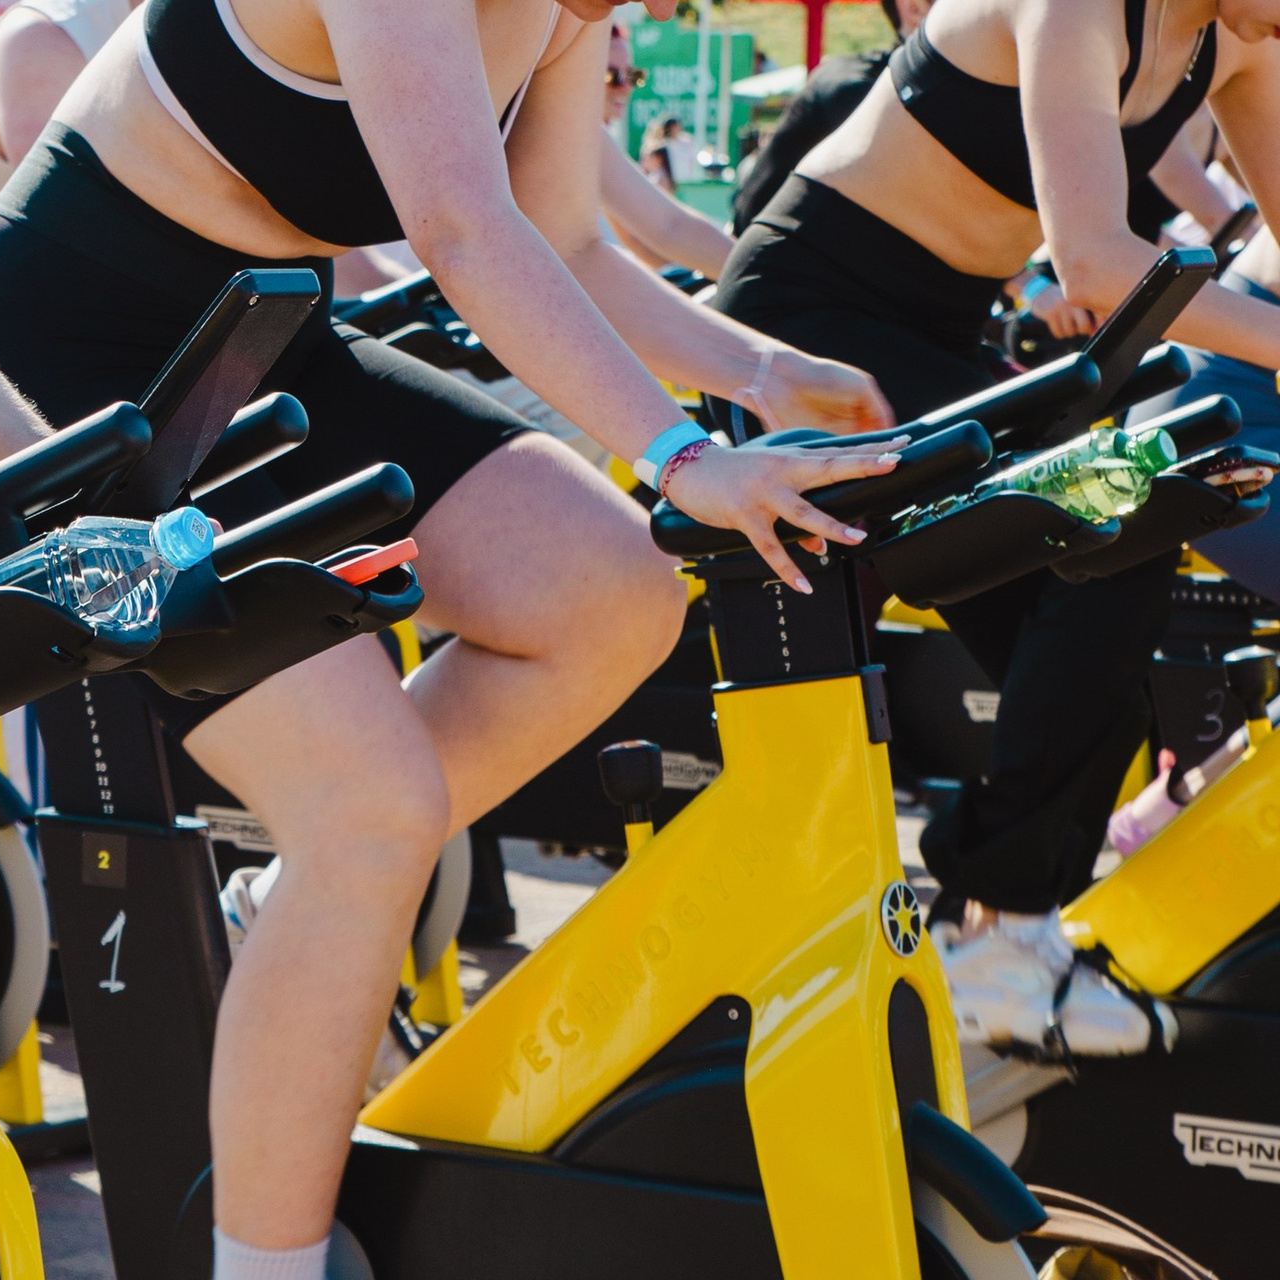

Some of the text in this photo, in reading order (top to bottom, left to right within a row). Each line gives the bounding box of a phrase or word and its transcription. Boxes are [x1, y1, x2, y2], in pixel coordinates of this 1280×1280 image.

[774, 584, 782, 595] 2
[776, 599, 784, 611] 3
[778, 615, 786, 626] 4
[780, 631, 788, 642] 5
[781, 646, 790, 657] 6
[784, 662, 791, 673] 7
[97, 849, 111, 870] 2
[98, 909, 127, 994] 1
[1179, 1122, 1280, 1172] TECHN
